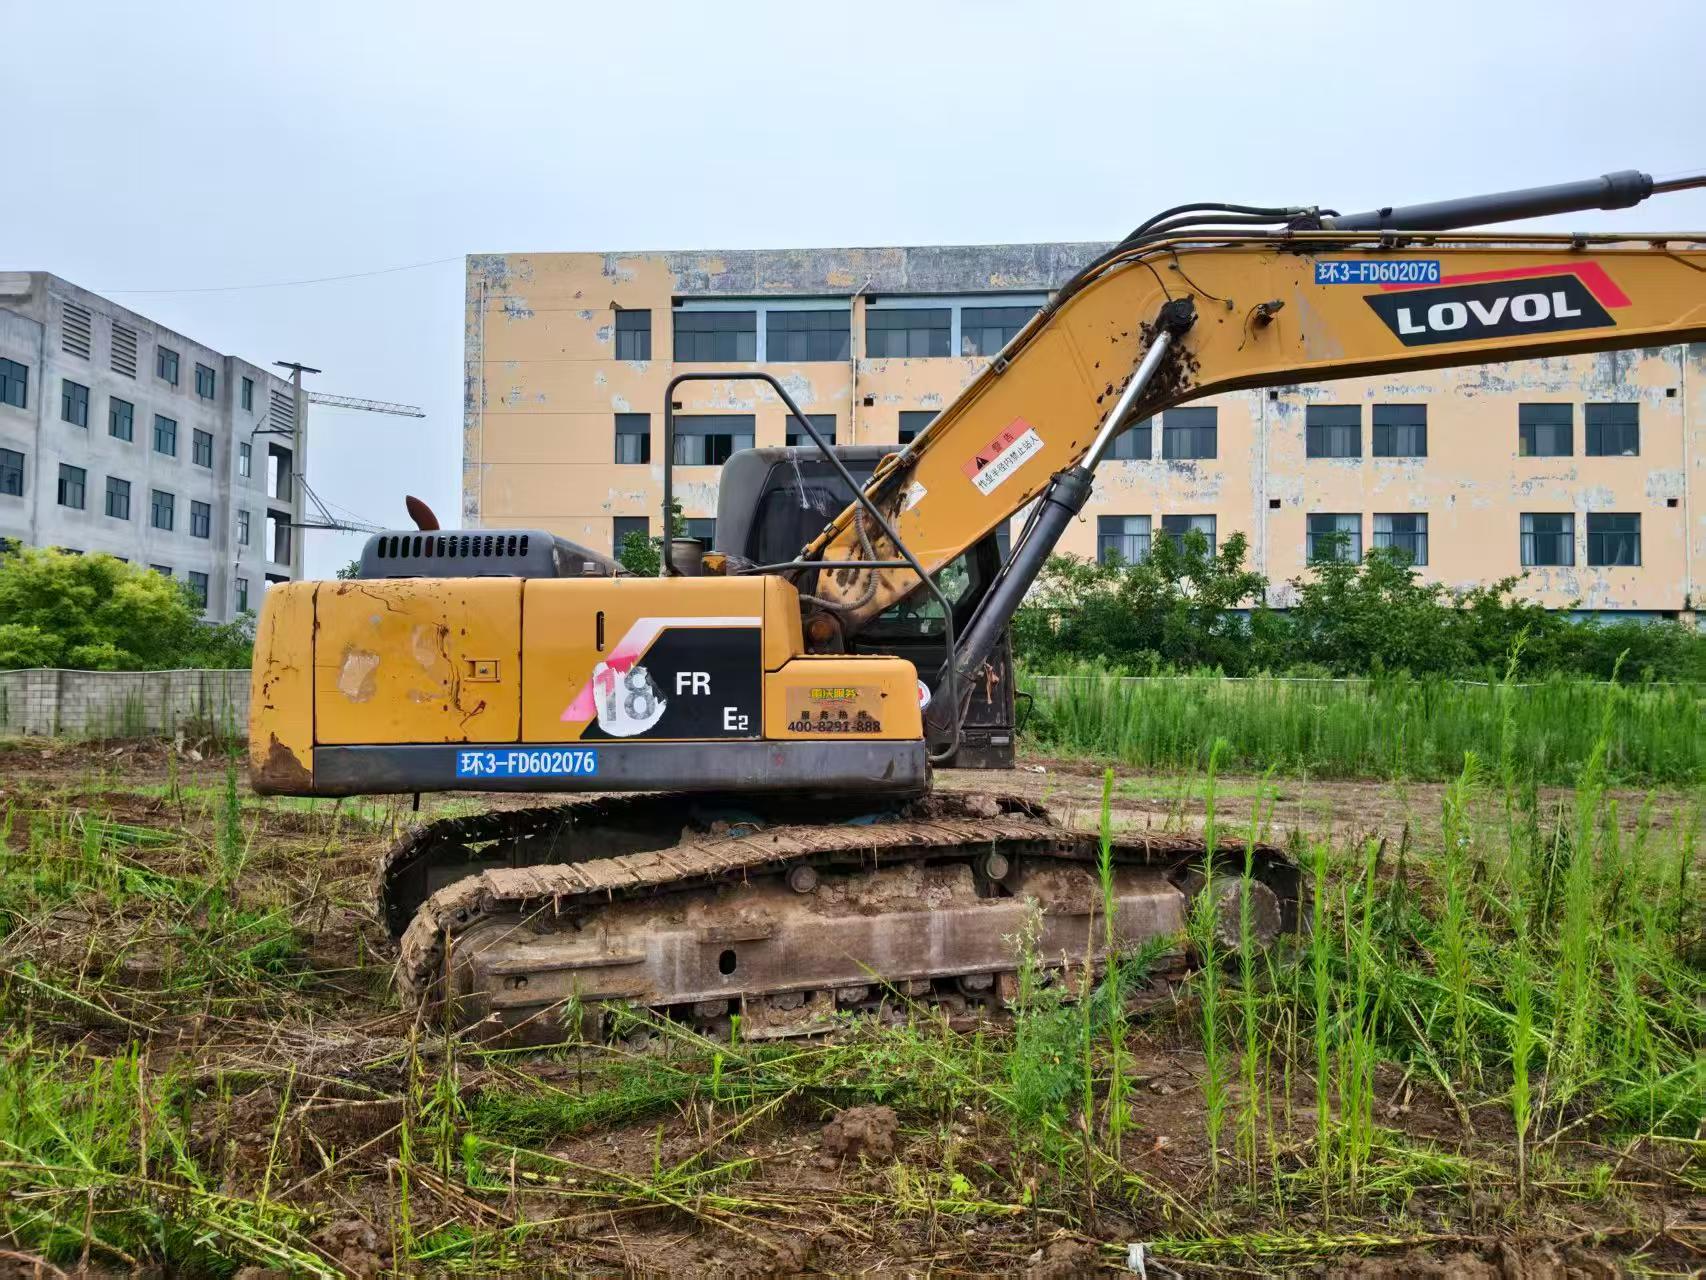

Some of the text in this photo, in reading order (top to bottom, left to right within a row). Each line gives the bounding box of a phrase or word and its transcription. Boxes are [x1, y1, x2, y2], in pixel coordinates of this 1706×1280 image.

[1319, 262, 1438, 282] 环3-FD602076
[1397, 291, 1581, 335] LOVOL
[676, 671, 711, 695] FR
[723, 707, 749, 730] E2
[788, 720, 881, 733] 400-8291-888
[461, 752, 595, 775] 环3-FD602076
